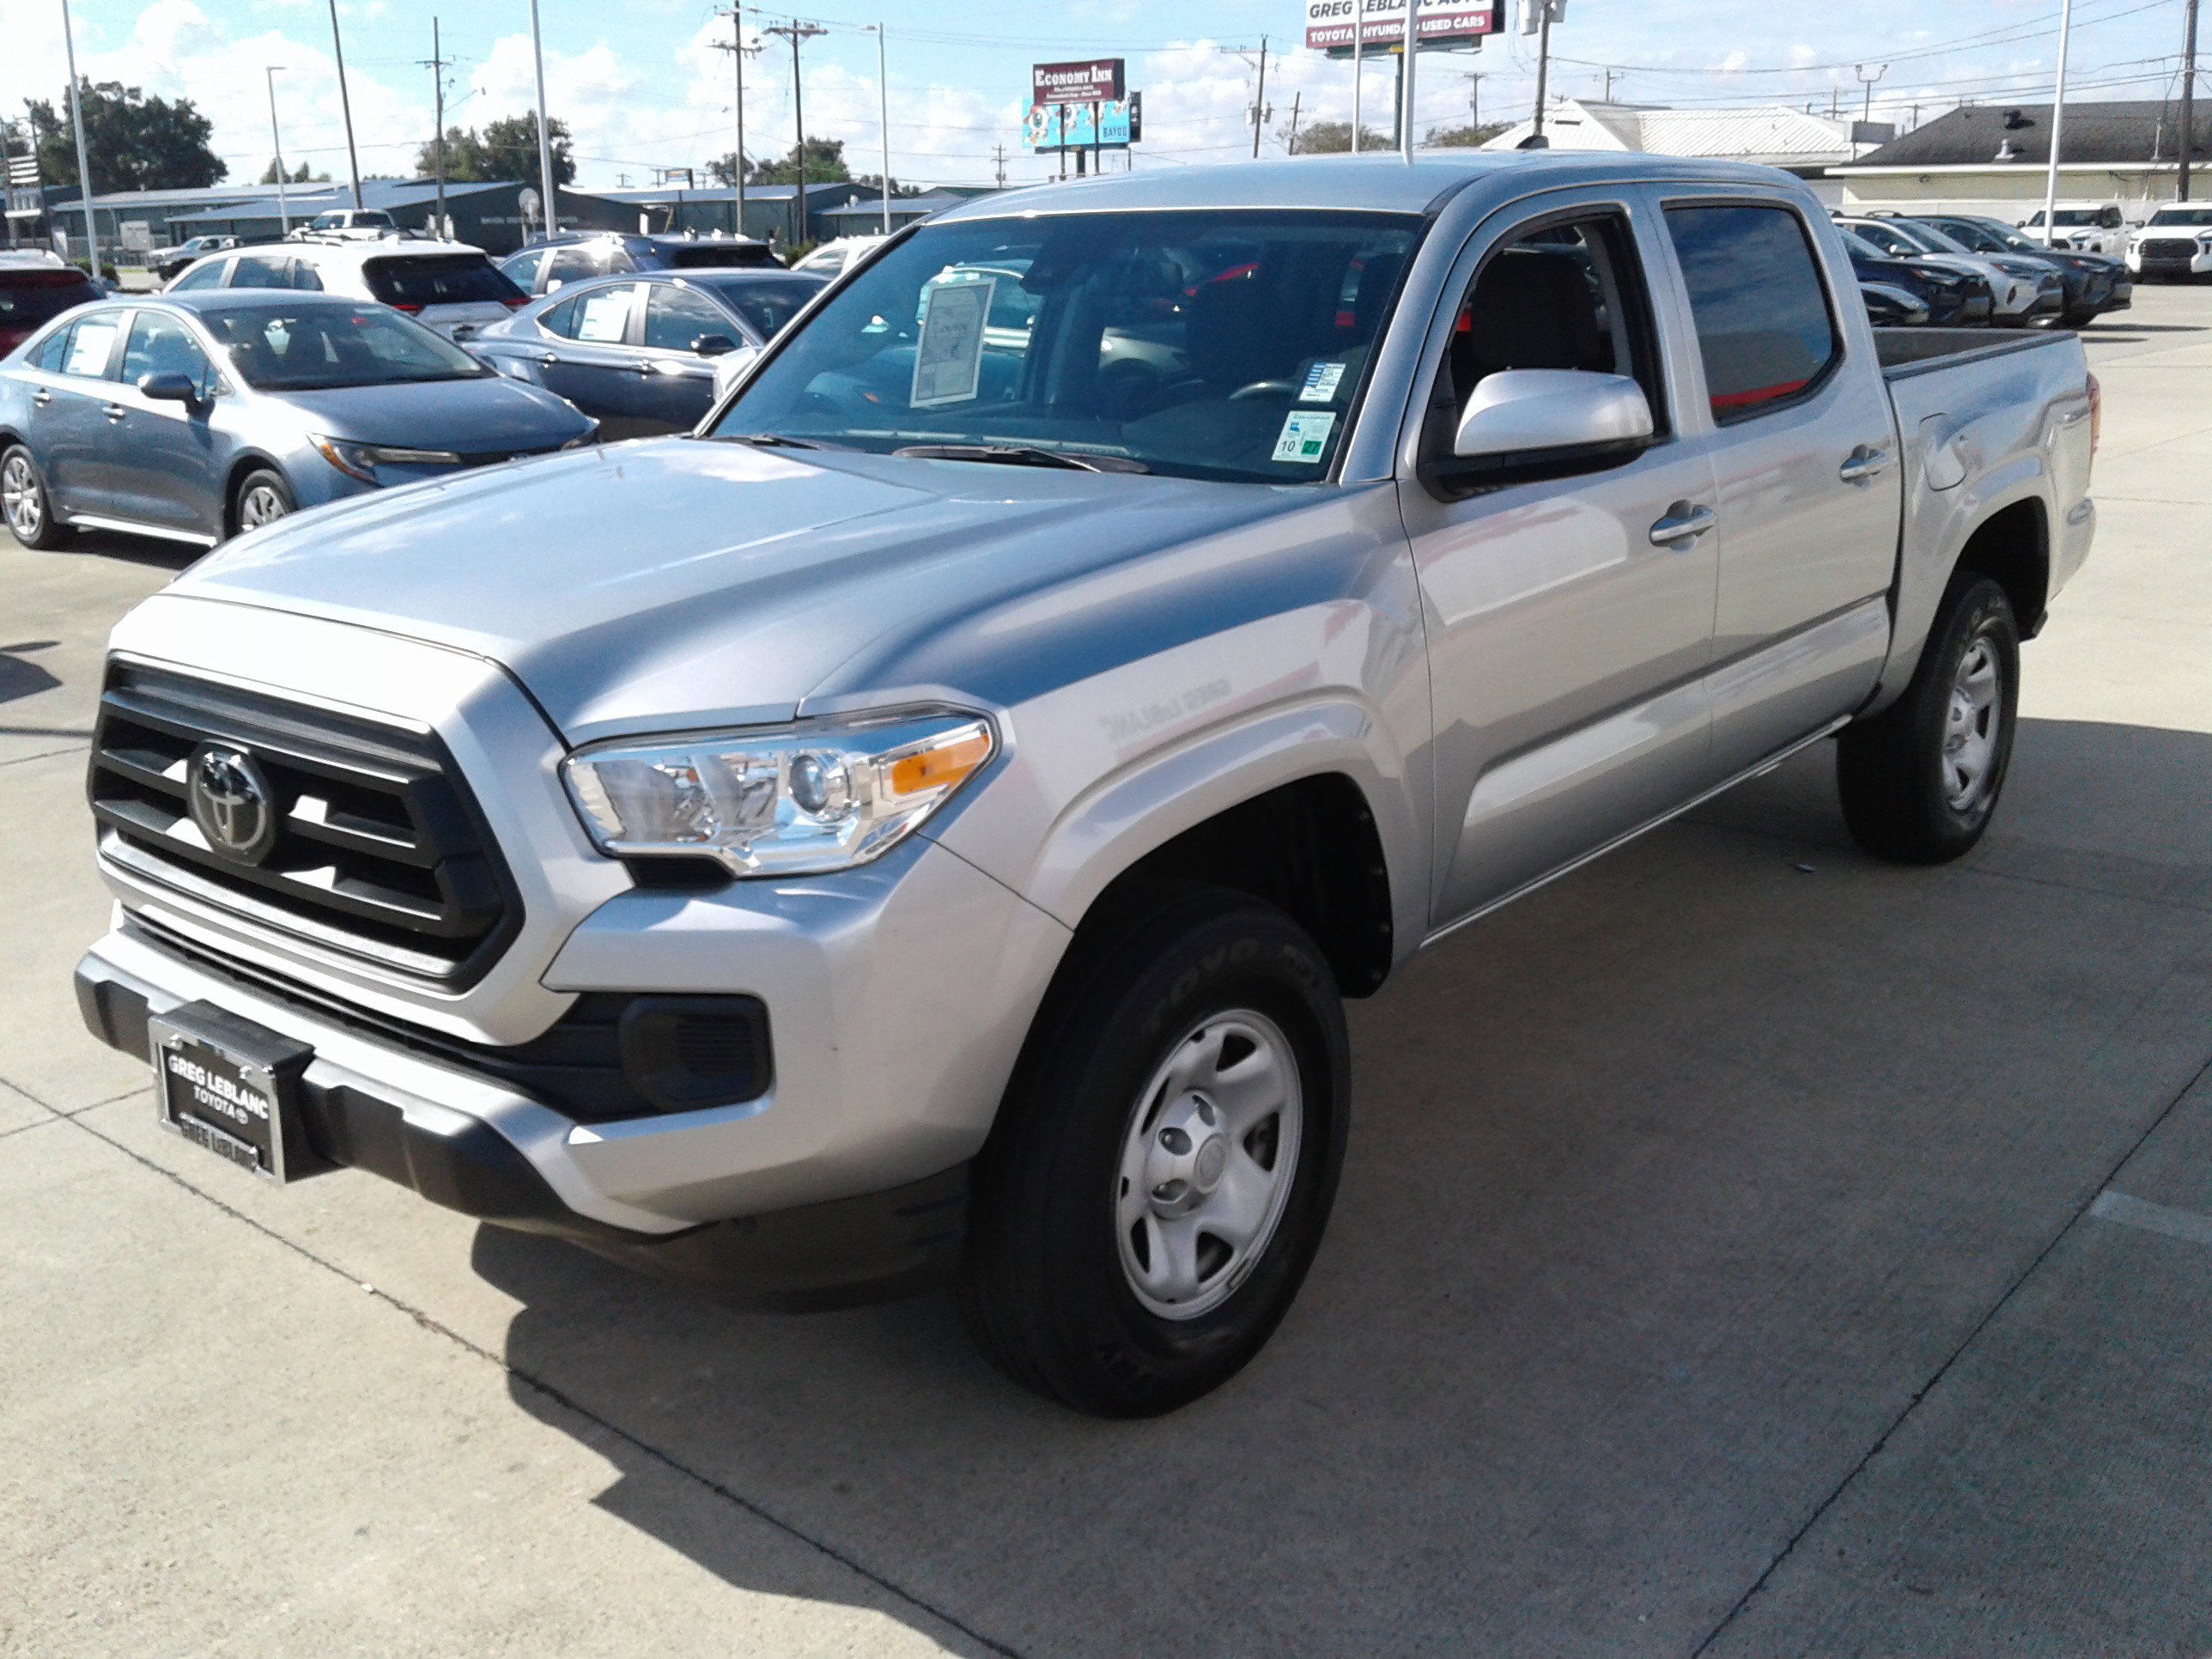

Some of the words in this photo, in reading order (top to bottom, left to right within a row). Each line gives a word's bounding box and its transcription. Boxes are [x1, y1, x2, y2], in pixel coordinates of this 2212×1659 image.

[1310, 1, 1352, 18] GREG
[1310, 27, 1354, 43] TOYOTA
[1362, 23, 1407, 39] HYUNDA
[1421, 19, 1452, 33] USED
[1453, 15, 1486, 29] CARS
[1035, 69, 1091, 87] ECONOMY
[1091, 64, 1113, 83] INN
[1280, 440, 1296, 453] 10
[1304, 440, 1321, 453] 27
[167, 1054, 206, 1086] GREG
[207, 1070, 270, 1120] LEBLANC
[193, 1085, 236, 1119] TOYOTA
